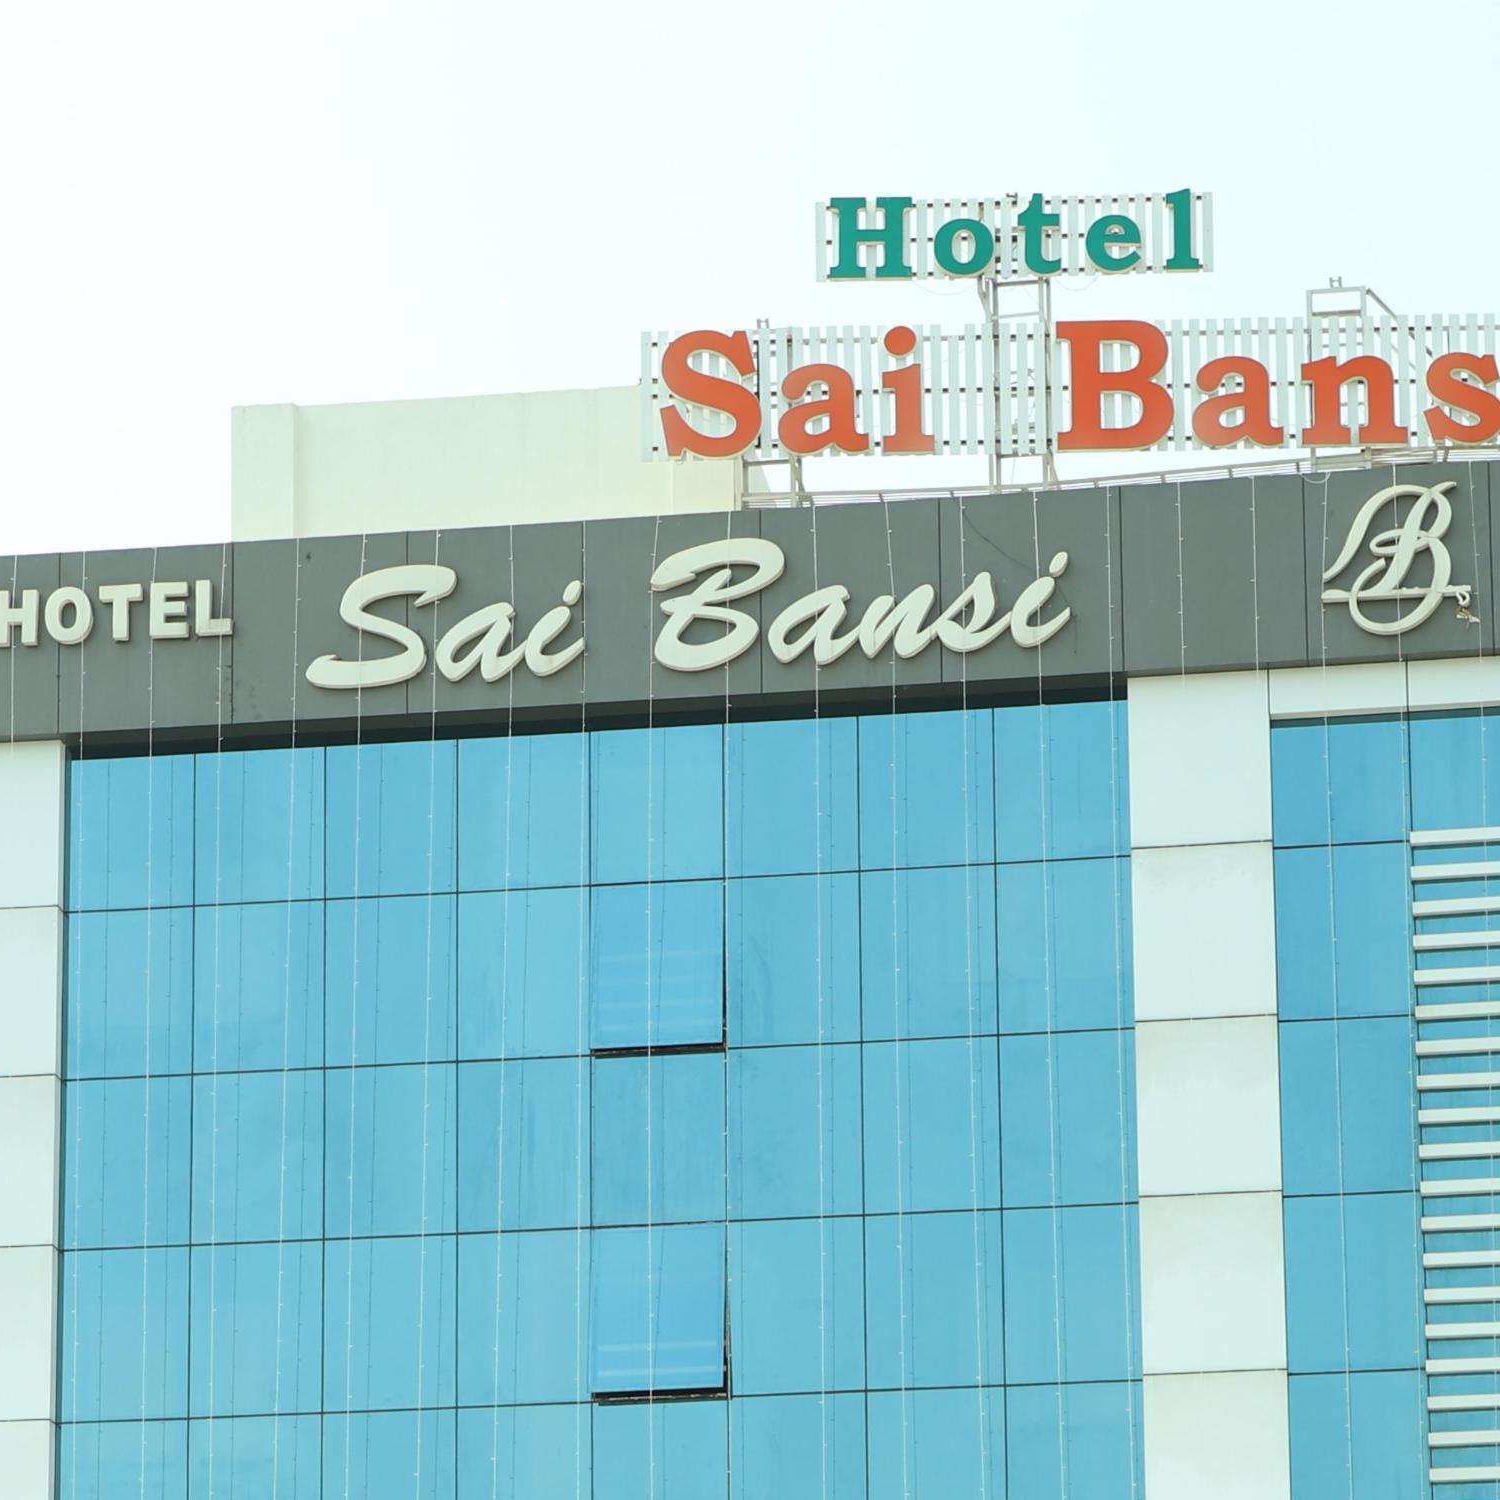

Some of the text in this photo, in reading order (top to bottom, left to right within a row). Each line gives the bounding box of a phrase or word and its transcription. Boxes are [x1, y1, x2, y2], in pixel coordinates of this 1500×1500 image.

[829, 189, 1202, 279] Hotel
[660, 325, 936, 460] Sai
[305, 565, 588, 690] Sai
[651, 537, 1073, 673] Bansi
